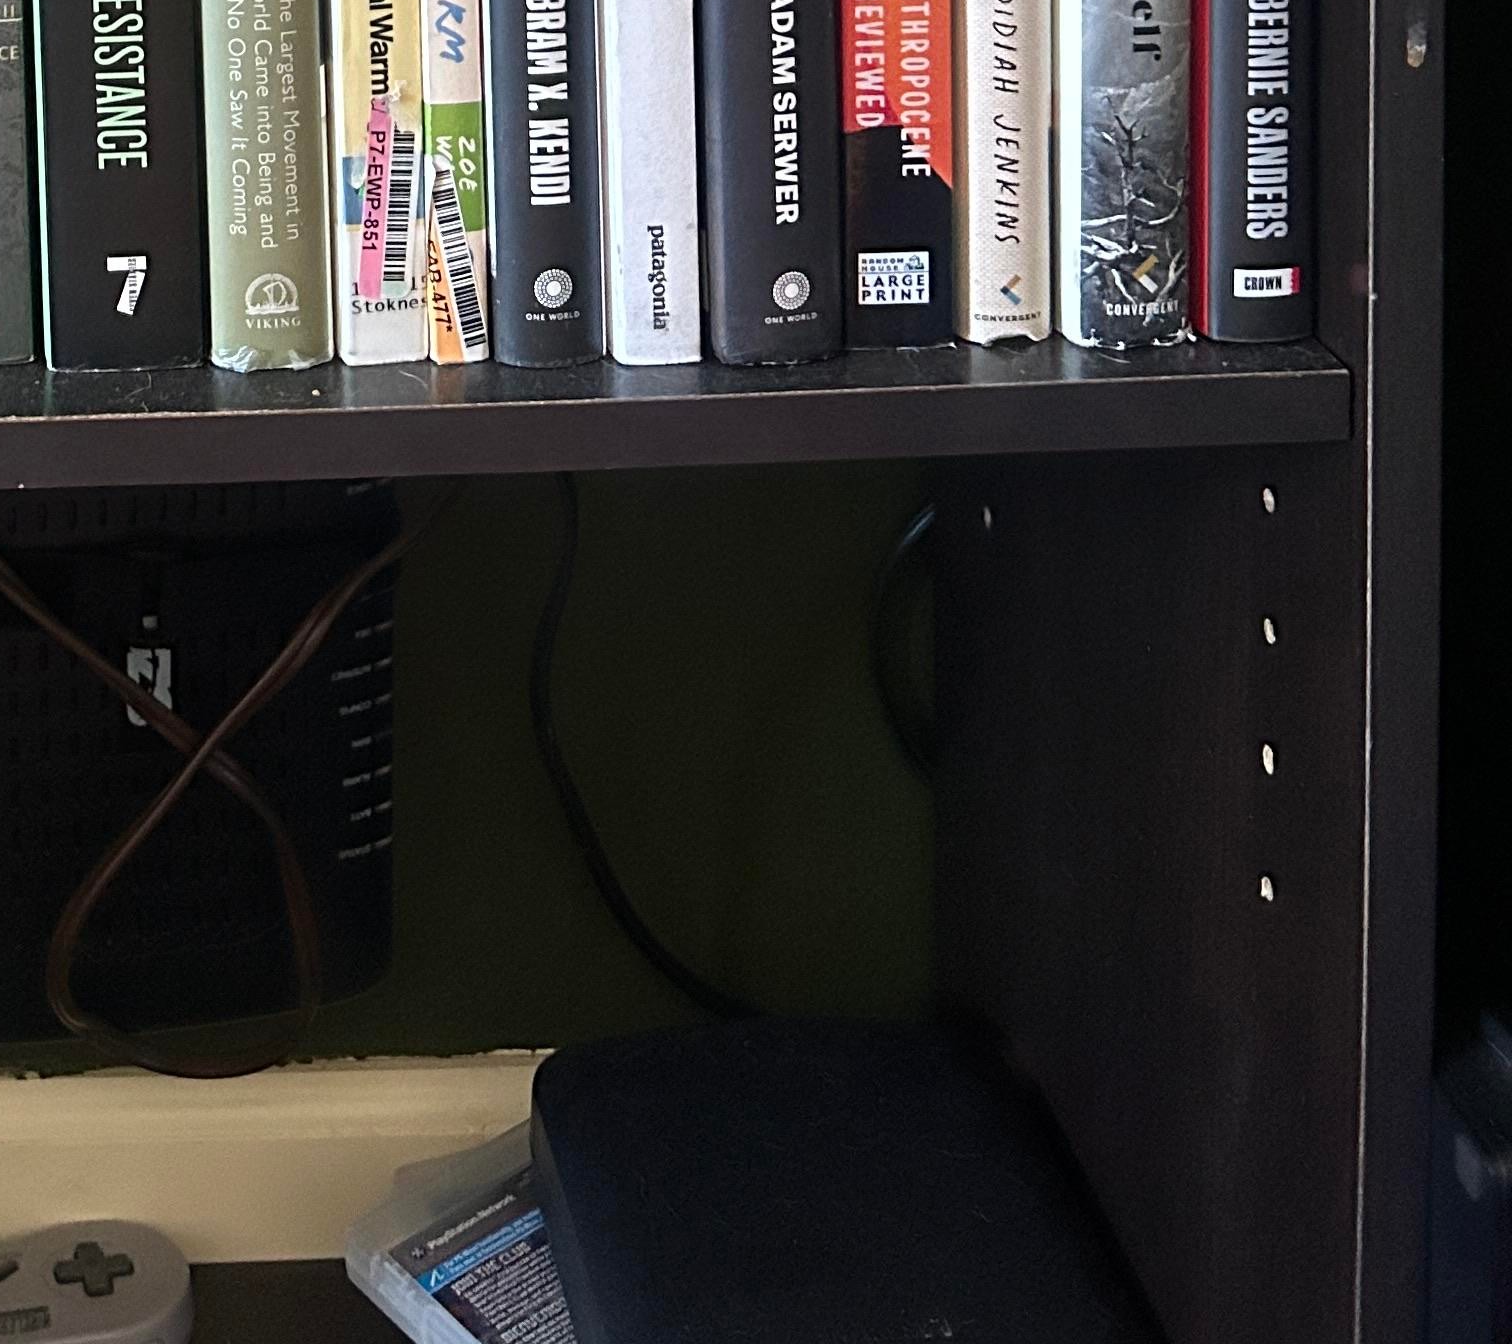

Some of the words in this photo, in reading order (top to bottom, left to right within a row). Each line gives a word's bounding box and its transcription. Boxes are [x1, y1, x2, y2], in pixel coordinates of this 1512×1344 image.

[528, 83, 569, 110] X.
[458, 136, 477, 191] ZOE
[529, 118, 571, 206] KENDI
[773, 92, 799, 224] SERWER
[1246, 106, 1290, 240] SANDERS
